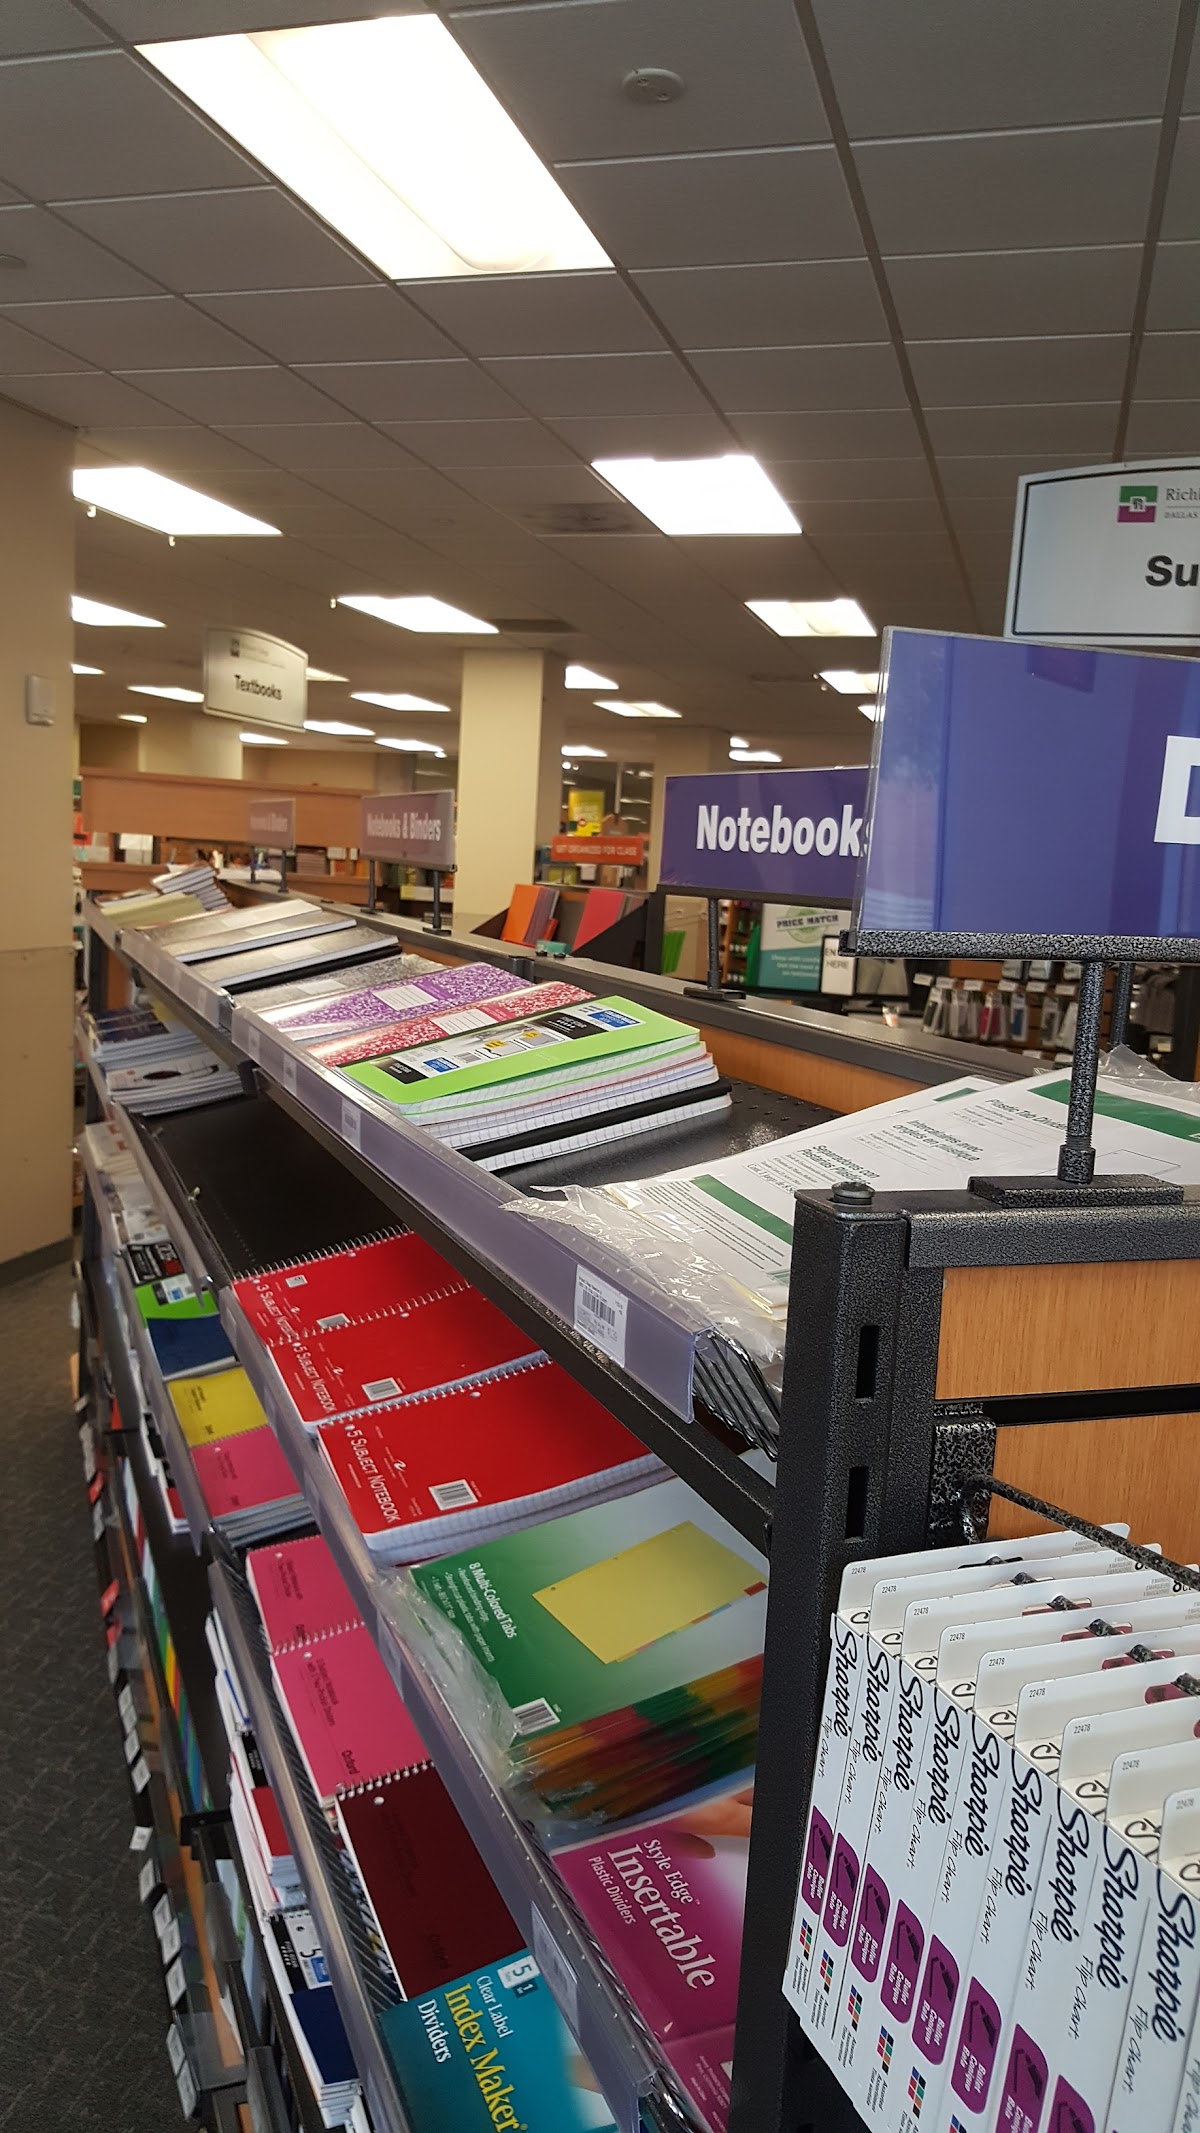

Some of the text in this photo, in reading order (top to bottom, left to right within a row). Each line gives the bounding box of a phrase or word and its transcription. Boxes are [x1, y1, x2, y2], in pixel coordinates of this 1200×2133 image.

[234, 674, 282, 700] Textbooks
[776, 914, 839, 928] PRICE MATCH
[256, 1284, 270, 1292] 3
[260, 1291, 283, 1317] SUBJECT
[296, 1352, 320, 1379] SUBJECT
[310, 1378, 338, 1414] NOTEBOOK
[346, 1430, 402, 1524] 5 SUBJECT NOTEBOOK
[851, 1566, 866, 1574] 22478
[472, 1568, 510, 1622] Multi-Colored
[500, 1617, 518, 1638] Tabs
[882, 1584, 897, 1594] 22478
[913, 1606, 929, 1616] 22478
[950, 1632, 966, 1642] 22478
[988, 1657, 1006, 1667] 22478
[831, 1616, 858, 1738] Sharpie
[861, 1635, 890, 1763] Sharpie
[1028, 1687, 1046, 1698] 22478
[893, 1659, 924, 1791] Sharpie
[1074, 1723, 1091, 1734] 22478
[342, 1750, 360, 1774] Oxford
[849, 1738, 861, 1764] Flip
[928, 1686, 960, 1824] Sharpie
[880, 1766, 892, 1792] Flip
[964, 1713, 1000, 1856] Sharpie
[913, 1798, 926, 1826] Flip
[1004, 1746, 1042, 1896] Sharpie
[644, 1839, 671, 1872] Style
[949, 1830, 963, 1857] Flip
[1048, 1786, 1089, 1942] Sharpie
[588, 1856, 637, 1925] Plastic Dividers
[988, 1868, 1002, 1896] Flip
[607, 1844, 716, 1990] Insertable
[840, 1905, 848, 1930] Bullet
[1096, 1826, 1139, 1990] Sharpie
[1032, 1910, 1048, 1941] Flip
[870, 1938, 878, 1965] Bullet
[1148, 1868, 1196, 2042] Sharpie
[512, 1964, 533, 1978] 5
[888, 1962, 898, 1984] Bala
[1076, 1955, 1094, 1988] Flip
[520, 1983, 535, 1992] 1
[901, 1976, 912, 2005] Bullet
[444, 1983, 488, 2053] Index
[476, 1975, 515, 2038] Clear Label
[920, 2000, 930, 2022] Bala
[417, 1998, 452, 2064] Dividers
[934, 2016, 946, 2046] Bullet
[1130, 2004, 1148, 2040] Flip
[960, 2044, 970, 2068] Bala
[974, 2062, 986, 2094] Bullet
[1004, 2094, 1016, 2120] Bala
